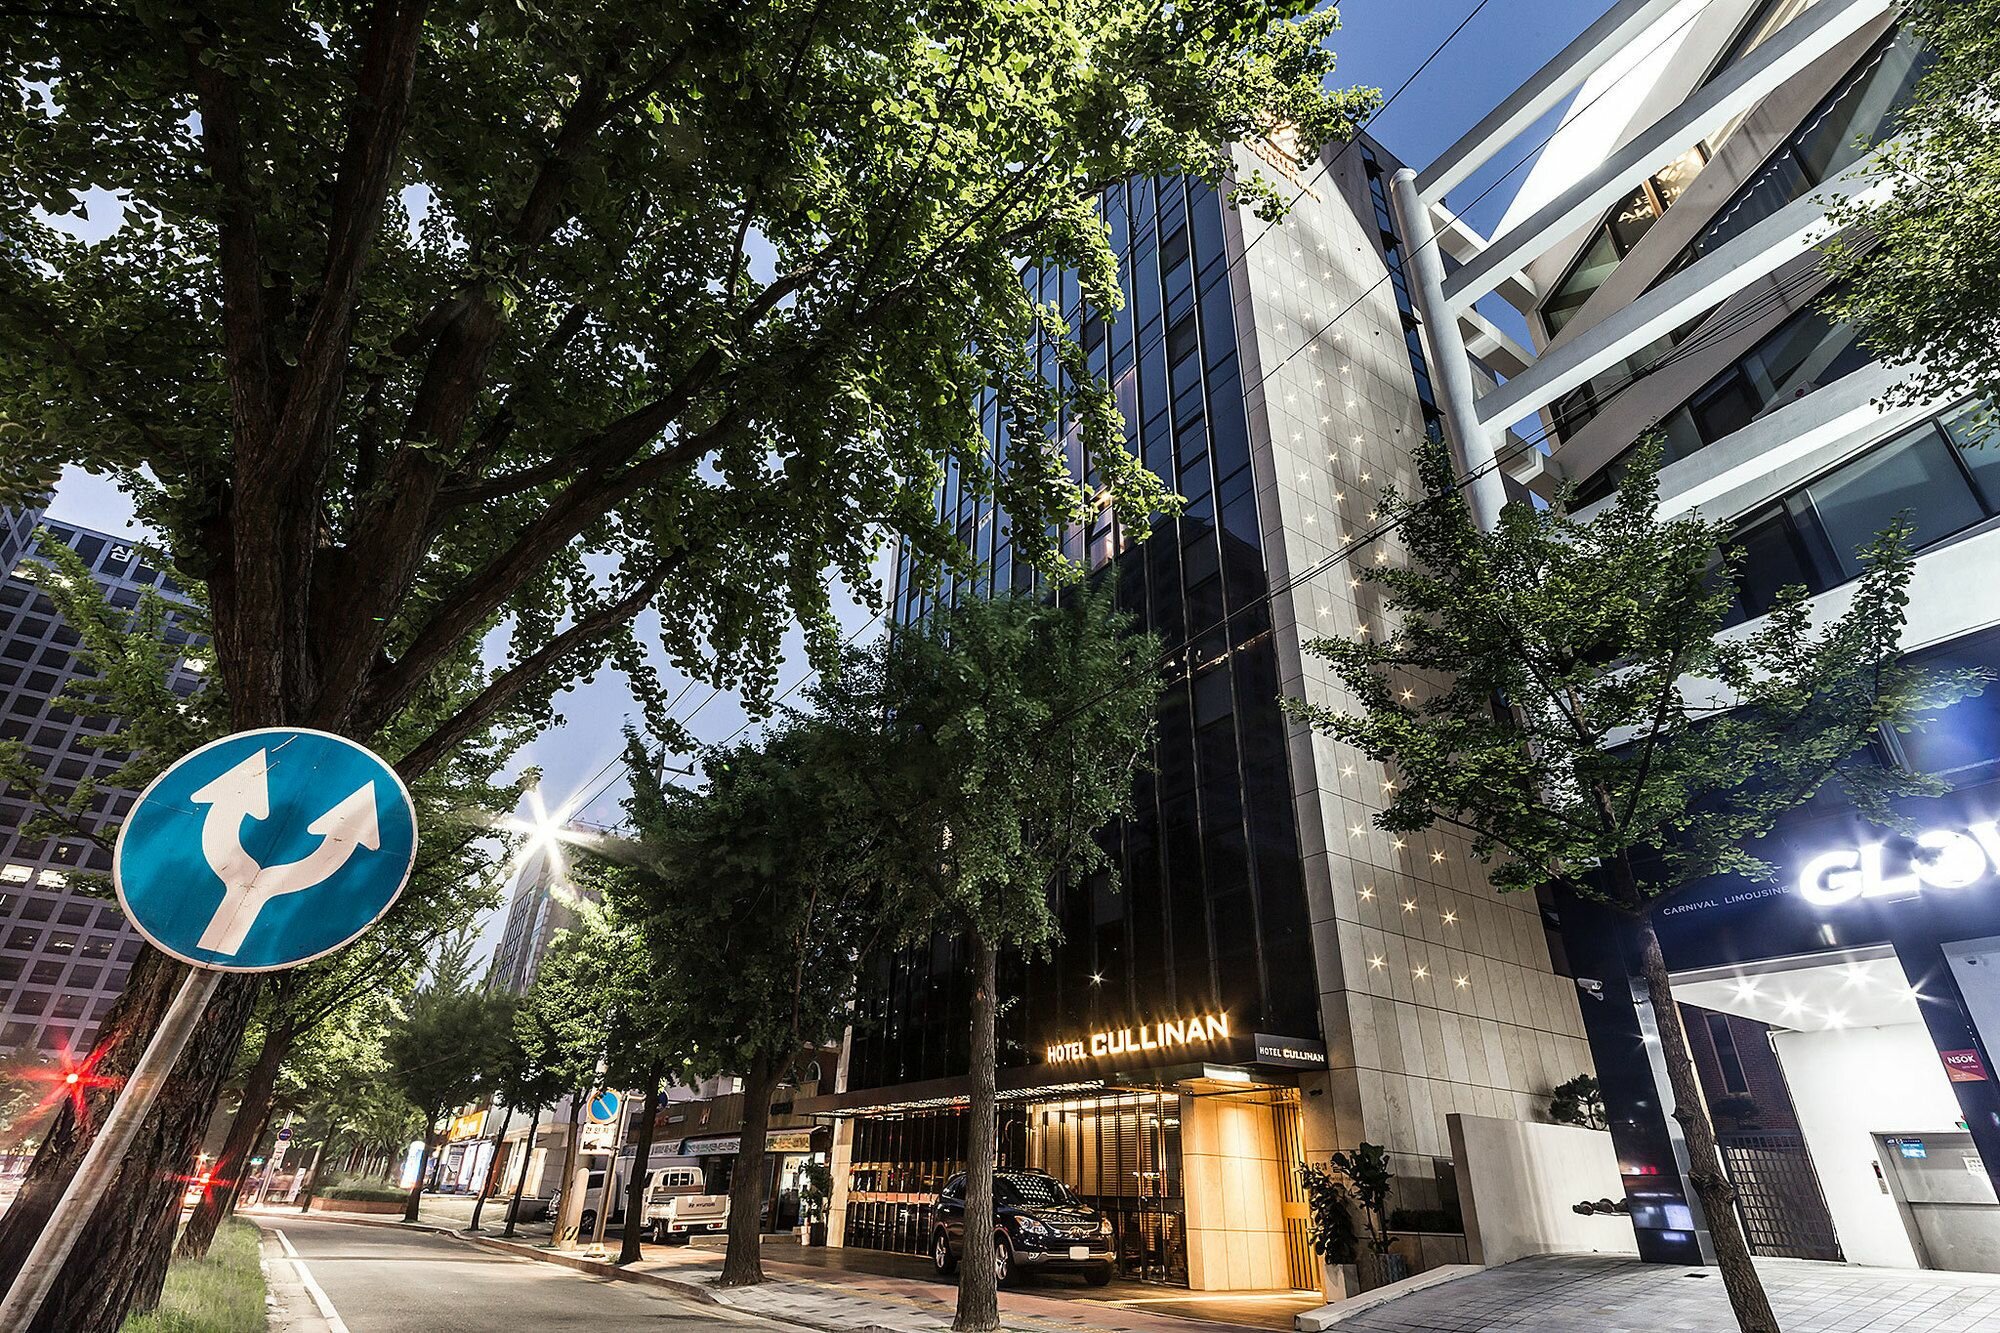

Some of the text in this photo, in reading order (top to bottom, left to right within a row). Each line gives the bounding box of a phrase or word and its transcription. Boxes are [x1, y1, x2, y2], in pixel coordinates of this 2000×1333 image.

[1663, 886, 1790, 916] CARNIVAL LIMOUSINE
[1047, 1012, 1229, 1063] HOTEL CULLINAN
[1259, 1046, 1325, 1062] HOTEL CULLINAN
[1946, 1055, 1976, 1064] NSOK
